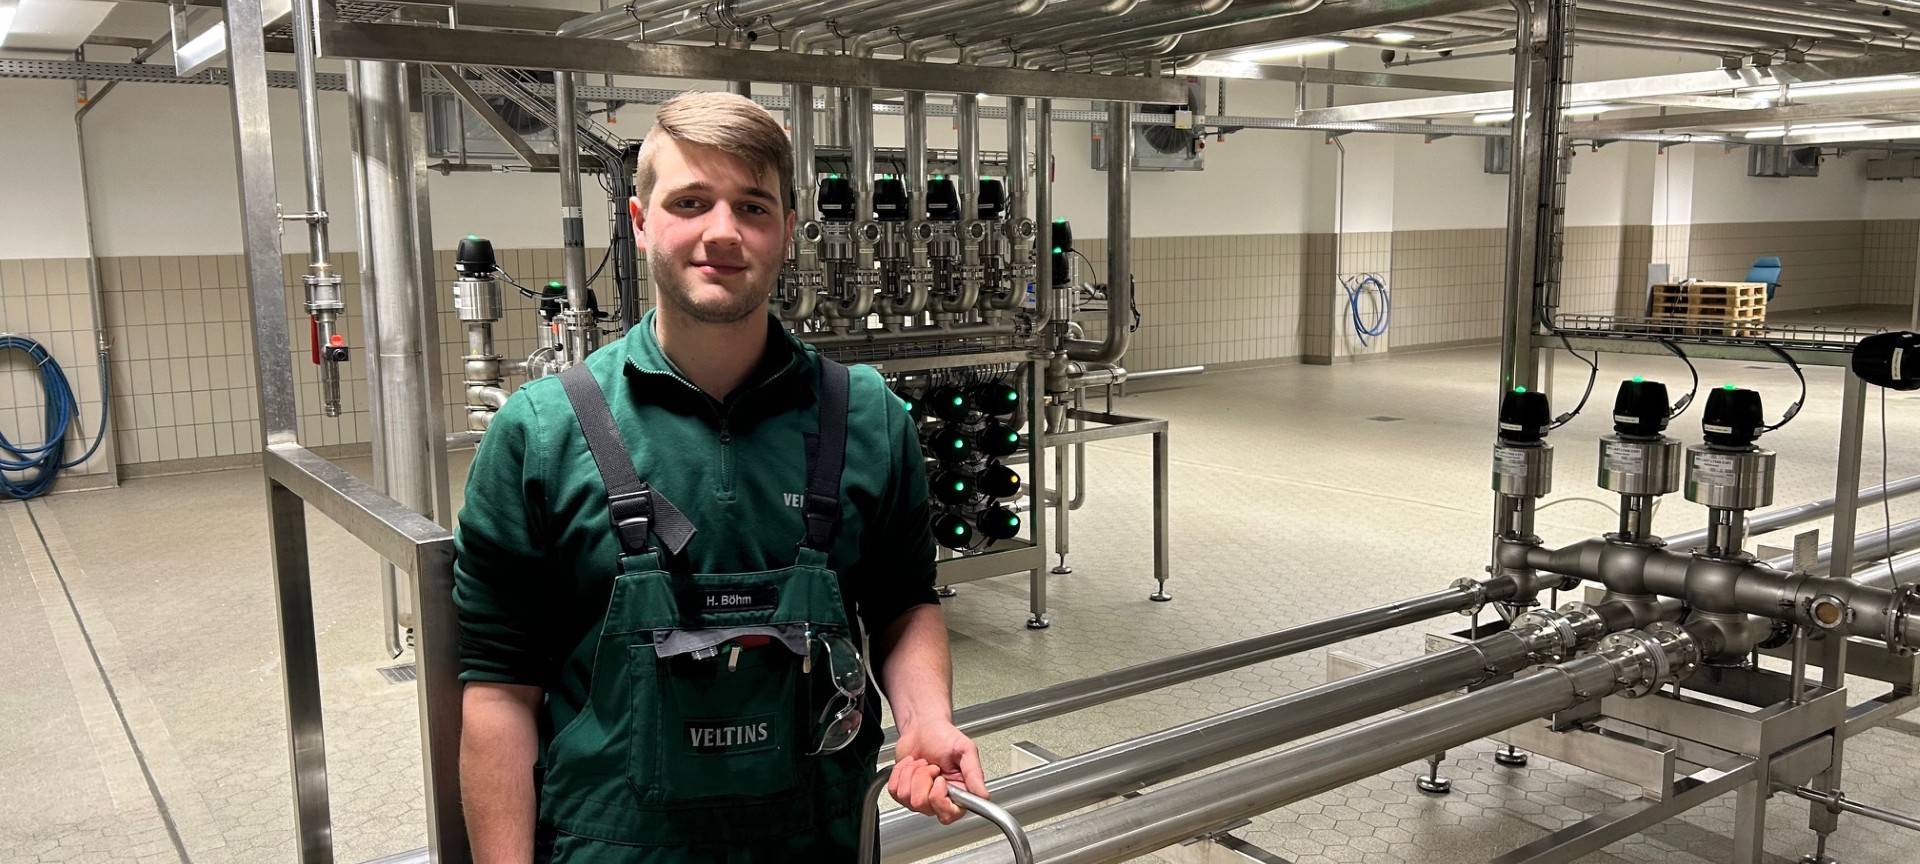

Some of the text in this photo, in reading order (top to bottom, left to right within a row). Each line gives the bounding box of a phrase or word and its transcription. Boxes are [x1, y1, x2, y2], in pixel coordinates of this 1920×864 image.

[706, 594, 752, 606] H. Böhm
[690, 722, 768, 747] VELTINS
